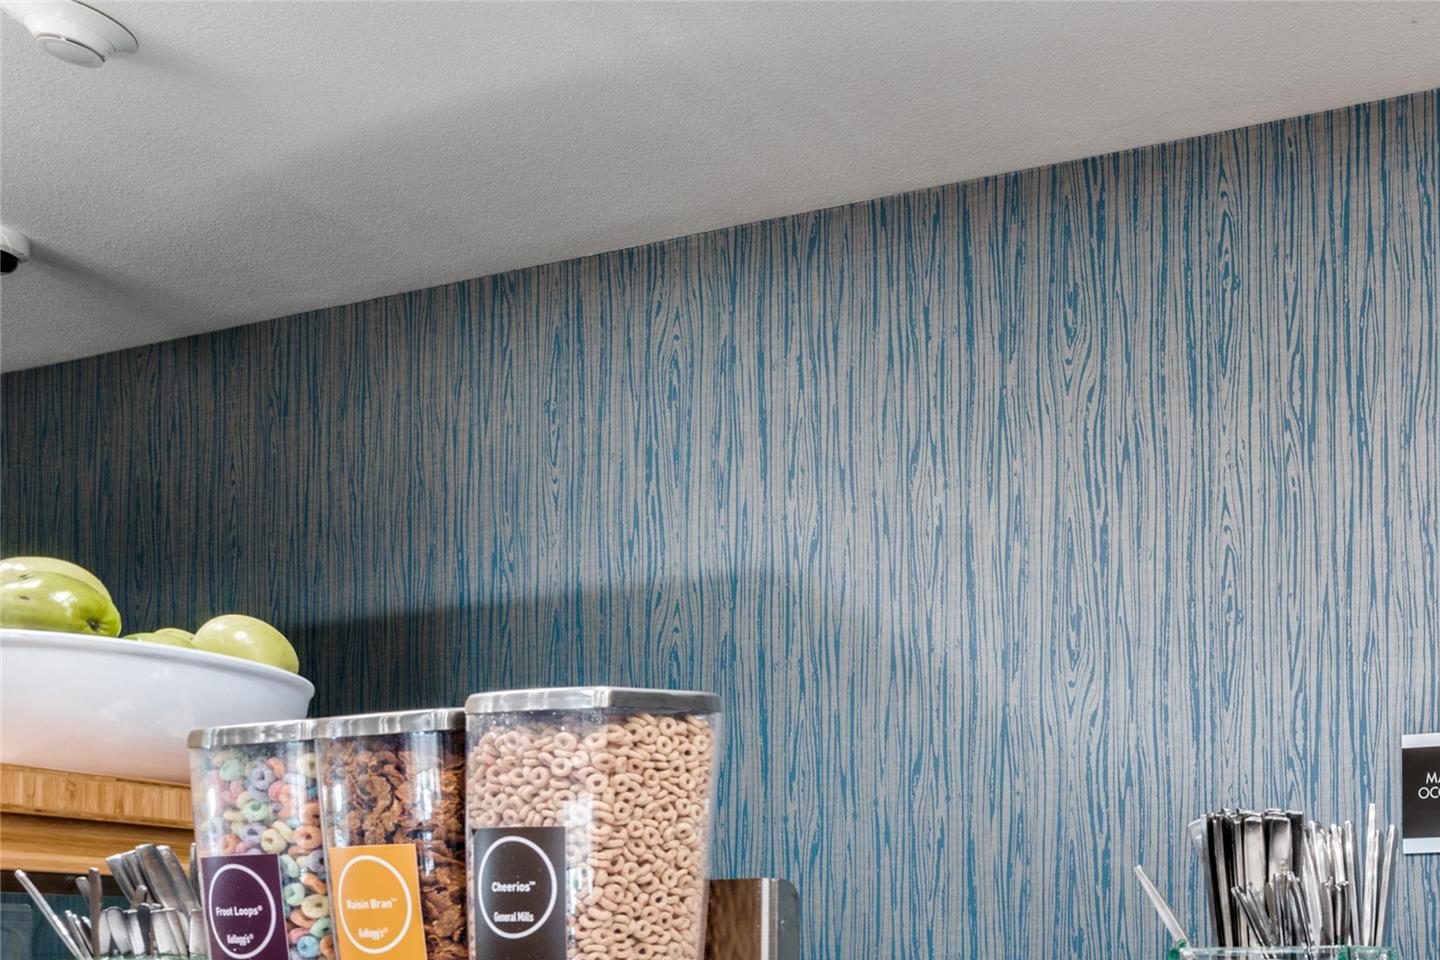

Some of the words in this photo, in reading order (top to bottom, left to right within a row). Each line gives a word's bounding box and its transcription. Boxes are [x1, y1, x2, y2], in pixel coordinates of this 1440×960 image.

[347, 900, 369, 910] Raisin
[493, 911, 516, 923] General
[517, 911, 535, 923] Mills
